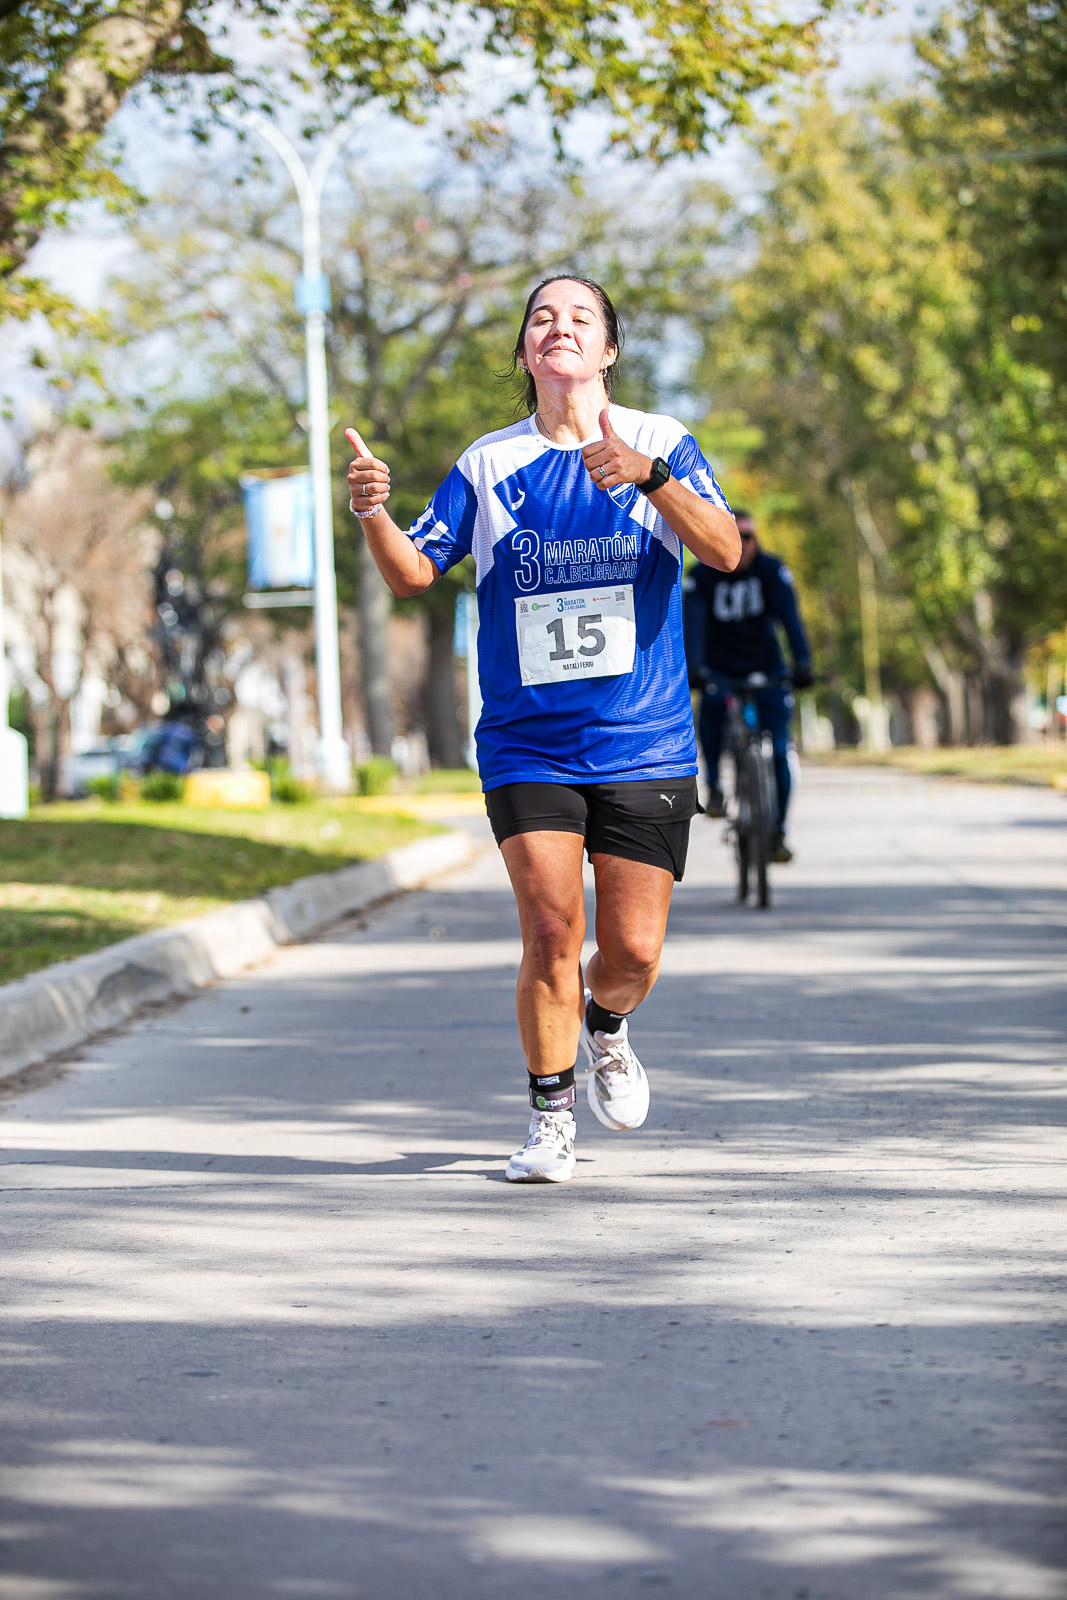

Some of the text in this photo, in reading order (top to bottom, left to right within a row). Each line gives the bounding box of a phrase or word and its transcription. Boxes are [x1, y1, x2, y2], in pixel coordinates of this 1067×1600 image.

[512, 529, 541, 592] 3
[544, 531, 638, 567] MARATÓN
[556, 597, 564, 613] 3
[546, 614, 606, 662] 15
